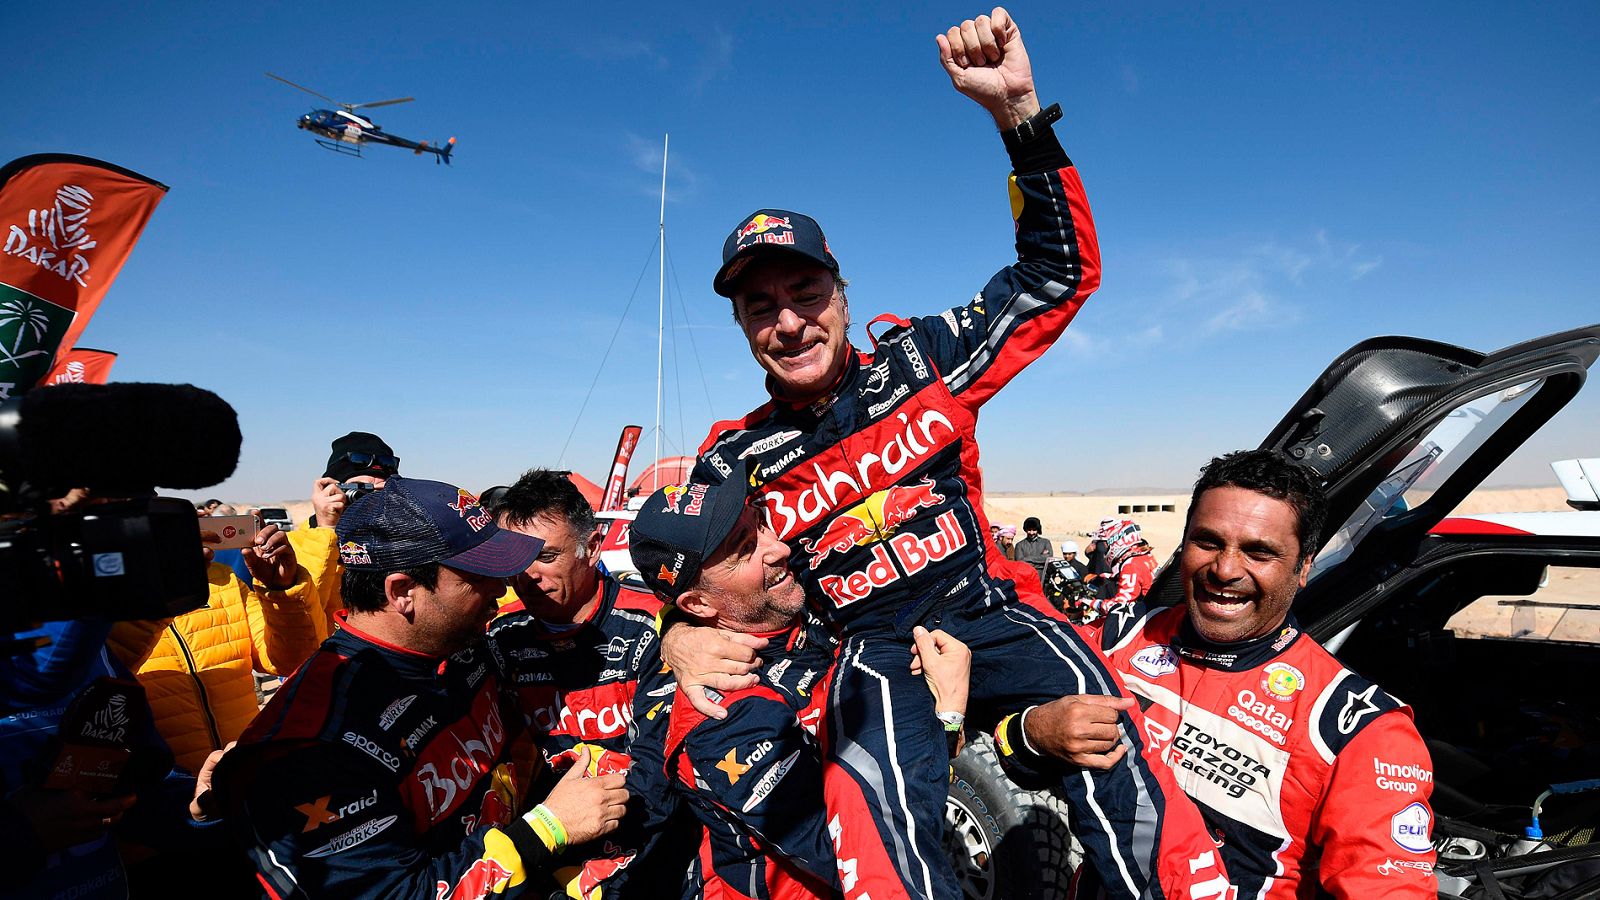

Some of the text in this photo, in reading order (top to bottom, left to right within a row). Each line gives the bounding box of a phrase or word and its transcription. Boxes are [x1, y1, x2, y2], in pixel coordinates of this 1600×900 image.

[764, 231, 795, 245] Bull
[3, 224, 88, 288] DAKAR
[901, 338, 928, 379] sparco
[753, 435, 785, 453] WORKS
[711, 452, 733, 477] spar
[755, 409, 954, 540] Bahrain
[761, 445, 805, 478] PRIMAX
[684, 490, 705, 516] Red
[467, 506, 493, 533] Red
[354, 554, 371, 565] Bull
[818, 509, 967, 609] Red Bull
[944, 577, 969, 598] ainz
[518, 672, 555, 683] PRIMAX
[1237, 689, 1293, 731] Qatar
[80, 721, 125, 743] DAKAR
[343, 731, 401, 770] sparco
[1173, 736, 1257, 787] GAZOO
[1183, 722, 1271, 780] TOYOTA
[756, 764, 786, 798] WORKS
[1170, 749, 1247, 799] Racing
[1376, 776, 1417, 795] Group
[331, 824, 379, 851] WORKS
